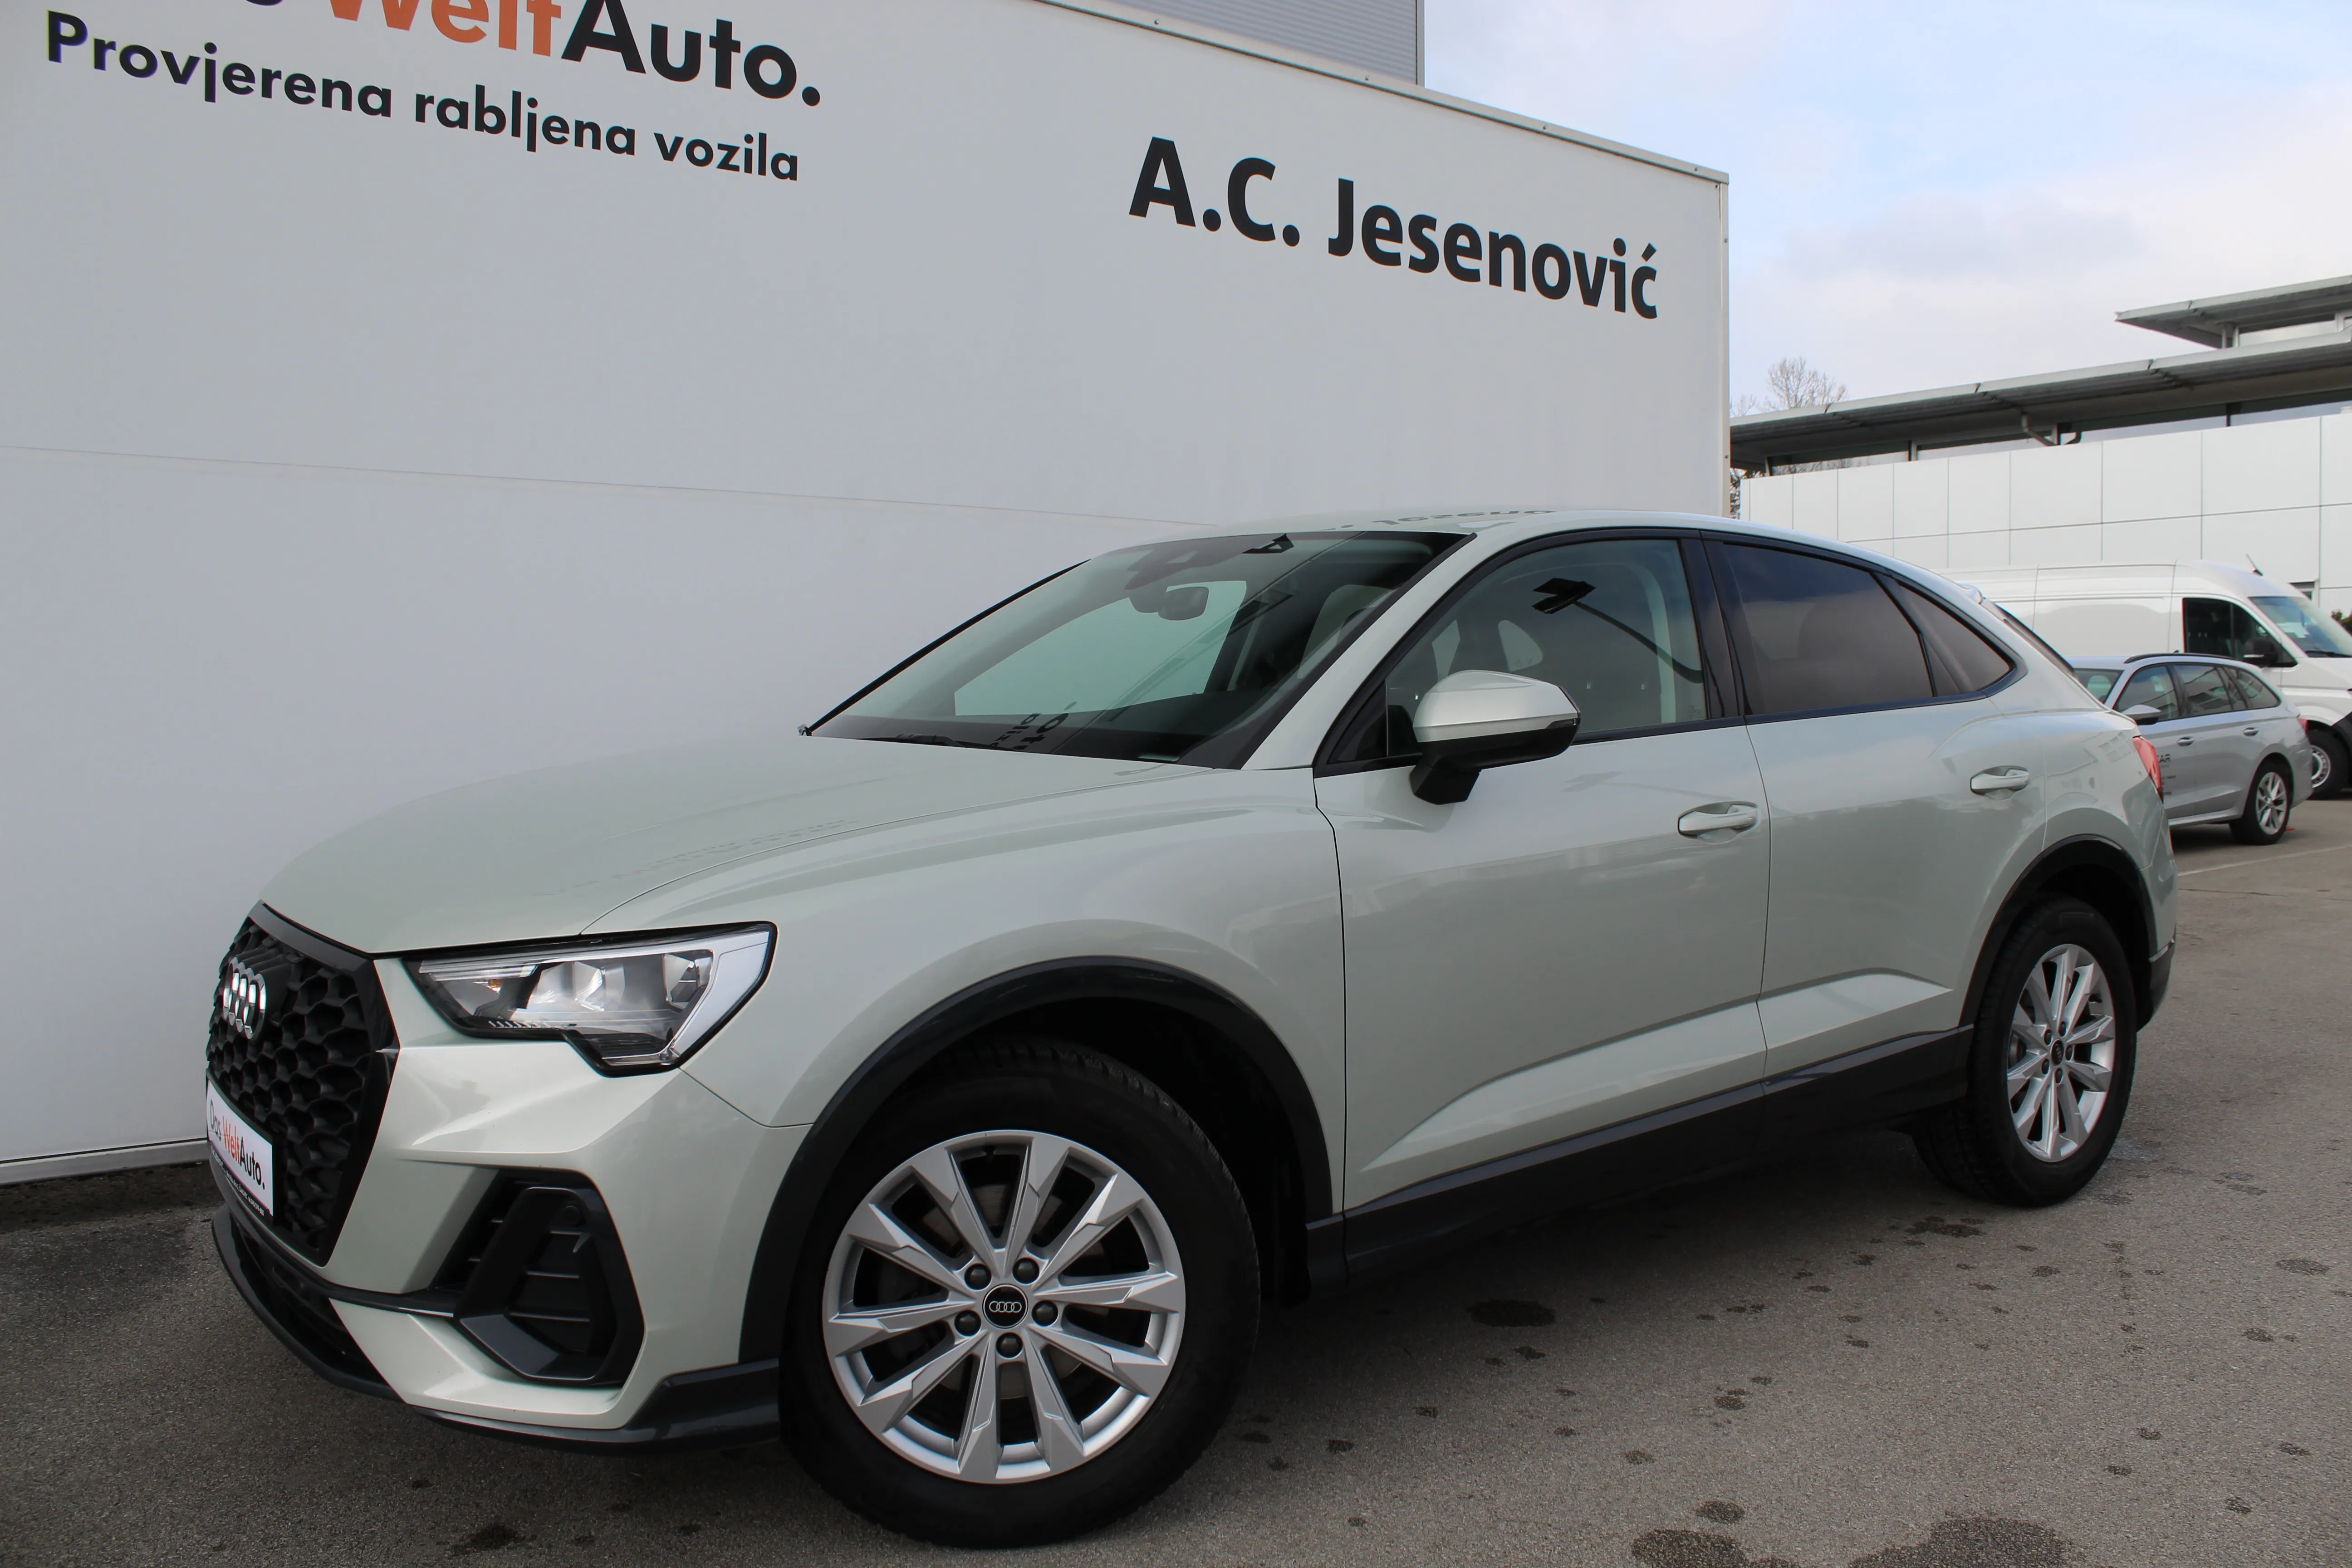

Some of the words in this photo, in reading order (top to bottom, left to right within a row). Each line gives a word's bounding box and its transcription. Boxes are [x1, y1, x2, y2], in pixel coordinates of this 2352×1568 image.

[47, 10, 392, 118] Provjerena
[415, 84, 635, 156] rabljena
[653, 132, 798, 181] vozila
[1129, 136, 1300, 247] A.C.
[1328, 178, 1657, 319] Jesenović
[210, 1099, 221, 1141] Das
[222, 1116, 265, 1190] WeltAuto.
